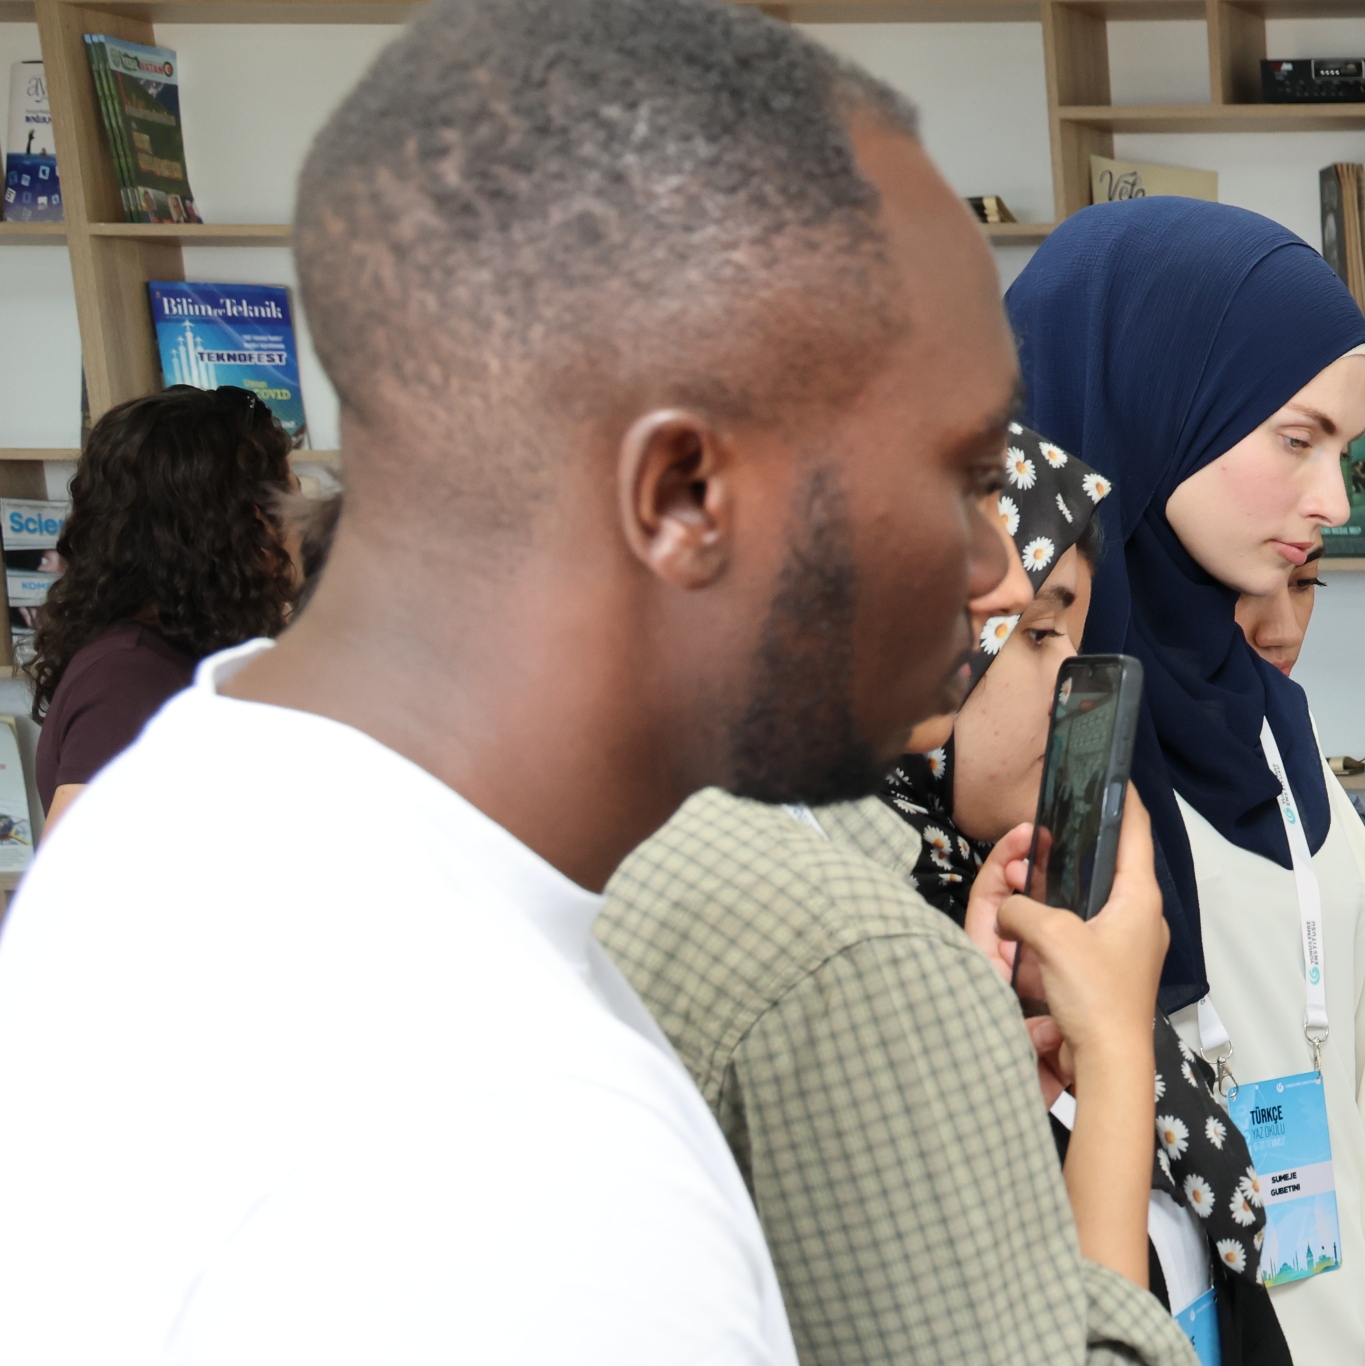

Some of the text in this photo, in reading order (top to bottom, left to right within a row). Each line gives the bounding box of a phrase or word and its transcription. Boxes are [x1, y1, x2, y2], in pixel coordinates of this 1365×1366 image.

[163, 297, 212, 316] Bilim
[220, 298, 283, 319] Teknik
[198, 351, 286, 363] TEKNOFEST
[1250, 1105, 1283, 1126] TÜRKÇE
[1252, 1123, 1286, 1140] YAZ OKULU
[1271, 1171, 1297, 1184] SUMEJE
